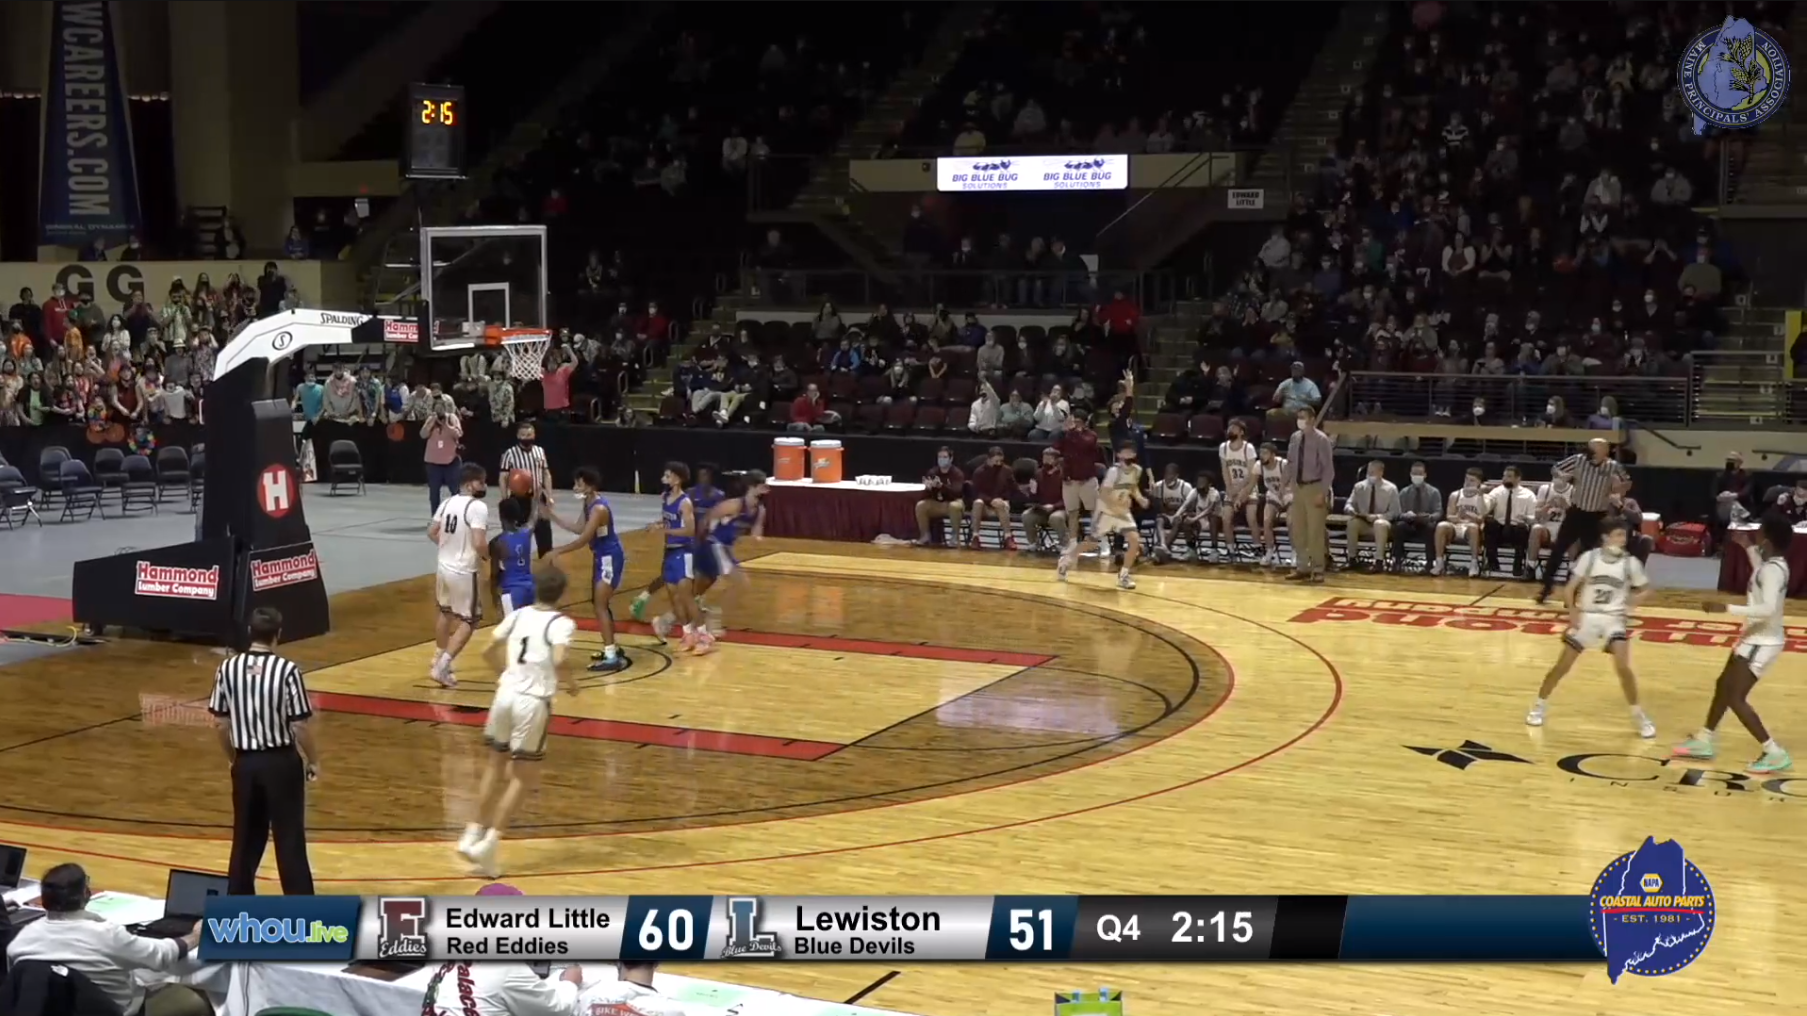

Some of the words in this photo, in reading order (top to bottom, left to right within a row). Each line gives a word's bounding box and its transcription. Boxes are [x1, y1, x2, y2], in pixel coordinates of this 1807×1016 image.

[422, 100, 453, 125] 2:15
[952, 174, 968, 182] BIG
[970, 173, 994, 181] BLUE
[997, 173, 1018, 181] BUG
[1043, 172, 1060, 181] BIG
[1063, 172, 1087, 180] BLUE
[1091, 171, 1112, 180] BUG
[1054, 181, 1101, 189] SOLUTIONS
[1232, 191, 1260, 199] EDWARD
[319, 313, 365, 326] SPALDING
[1232, 468, 1244, 479] 32
[263, 470, 289, 511] H
[444, 513, 458, 534] 10
[137, 562, 219, 584] Hammond
[251, 551, 316, 577] Hammond
[254, 575, 281, 587] Lumber
[282, 569, 316, 582] Company
[138, 581, 170, 593] Lumber
[172, 583, 215, 597] Company
[517, 636, 530, 665] 1
[457, 960, 480, 1016] alace
